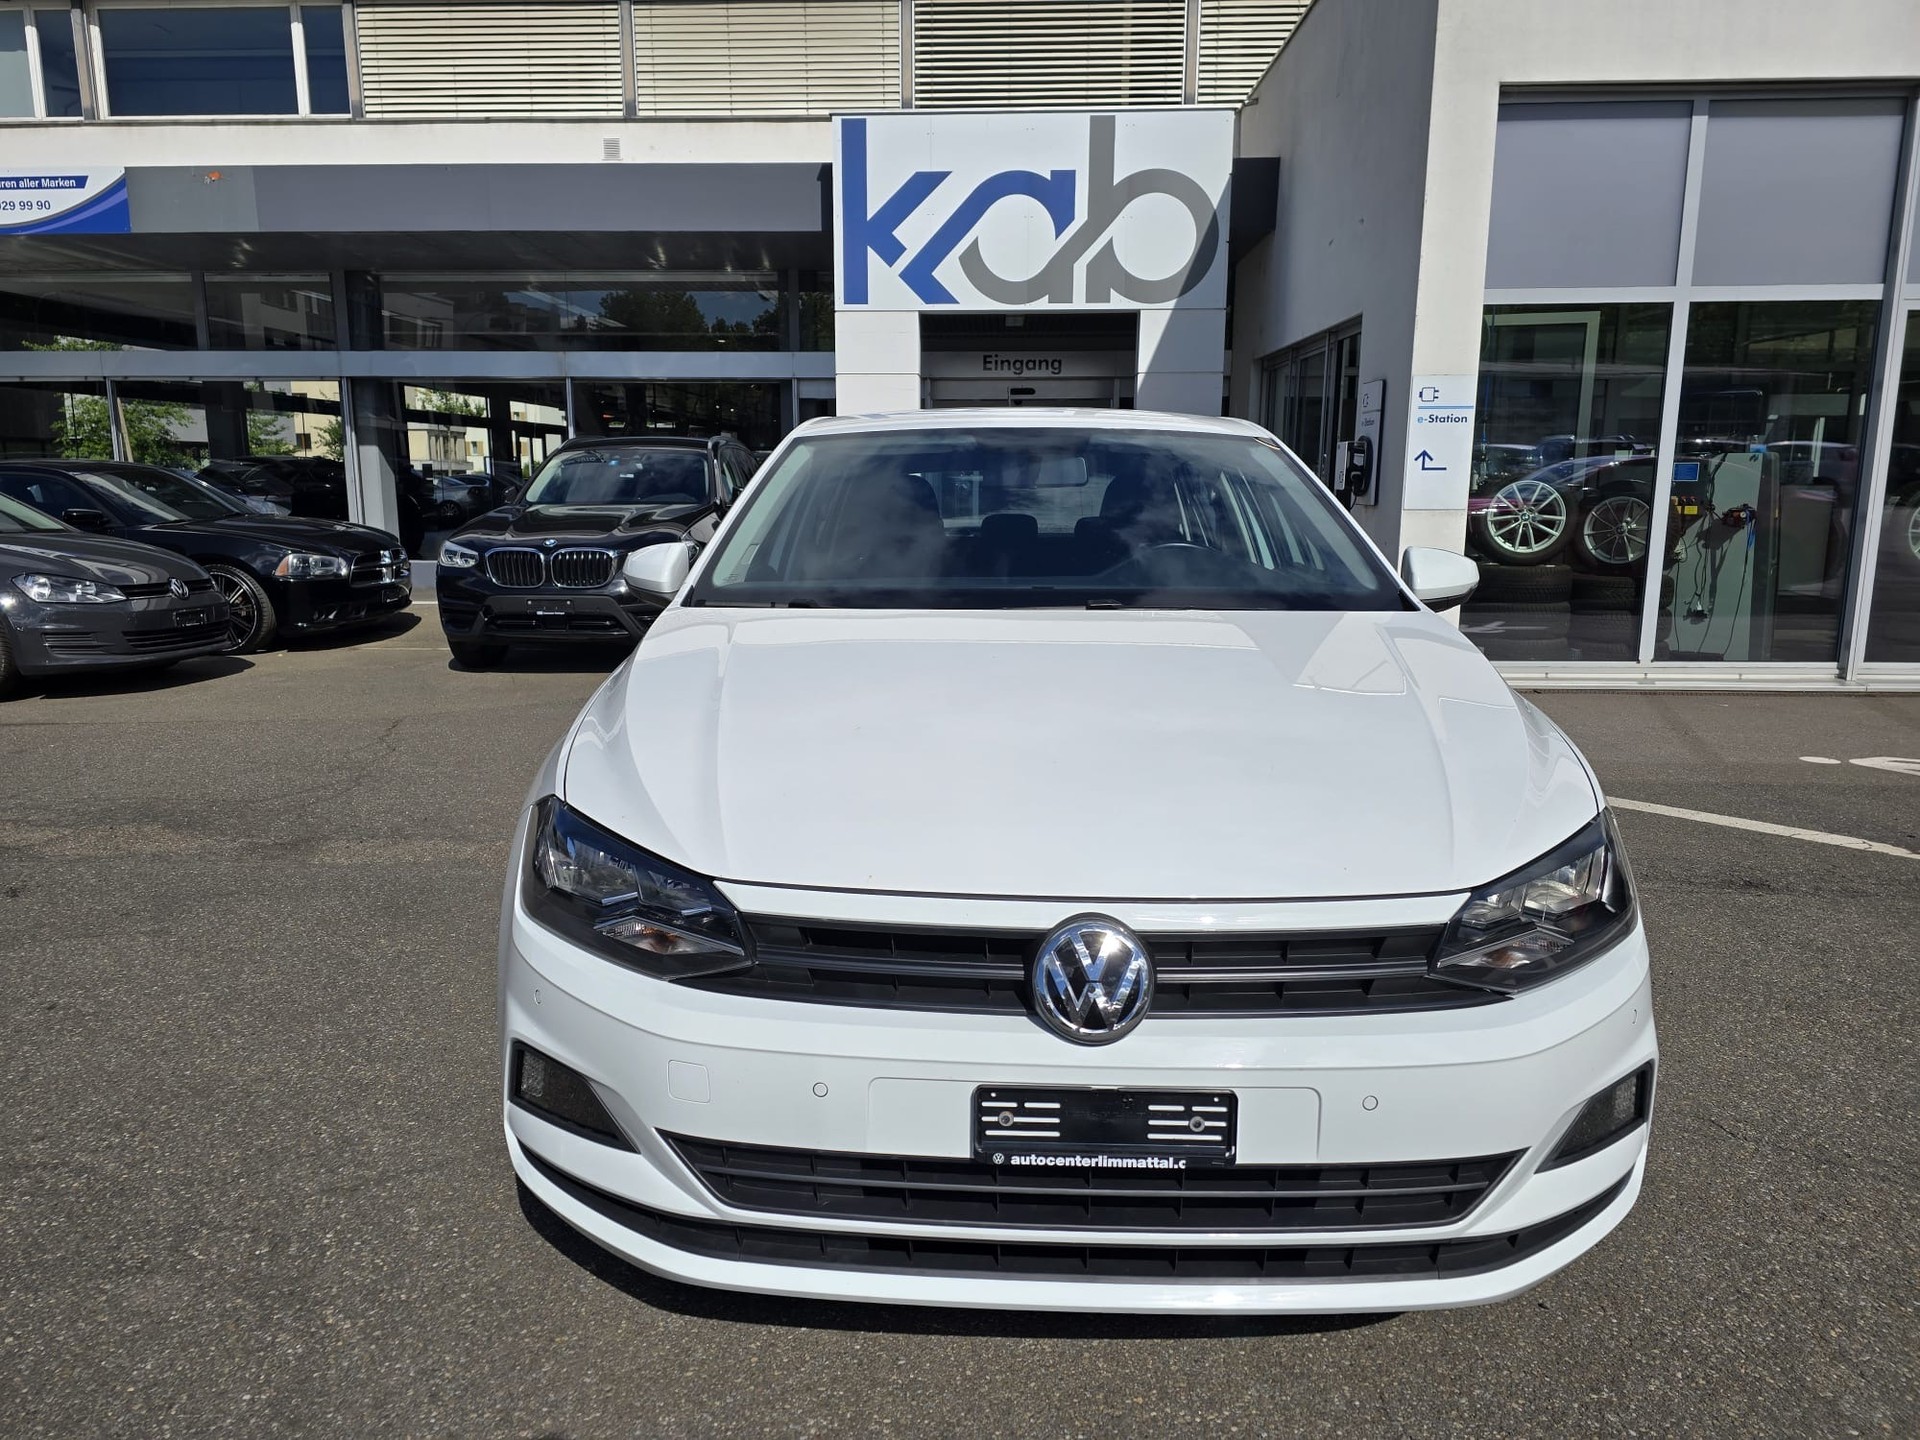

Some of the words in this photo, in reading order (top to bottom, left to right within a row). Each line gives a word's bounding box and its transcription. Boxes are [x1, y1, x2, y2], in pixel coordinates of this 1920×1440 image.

[0, 180, 17, 189] ren
[19, 178, 39, 188] aller
[41, 177, 76, 188] Marken
[0, 200, 16, 211] 29
[19, 200, 33, 211] 99
[36, 200, 51, 211] 90
[841, 115, 1219, 305] kab
[982, 354, 1062, 375] Eingang
[1417, 413, 1468, 424] e-Station
